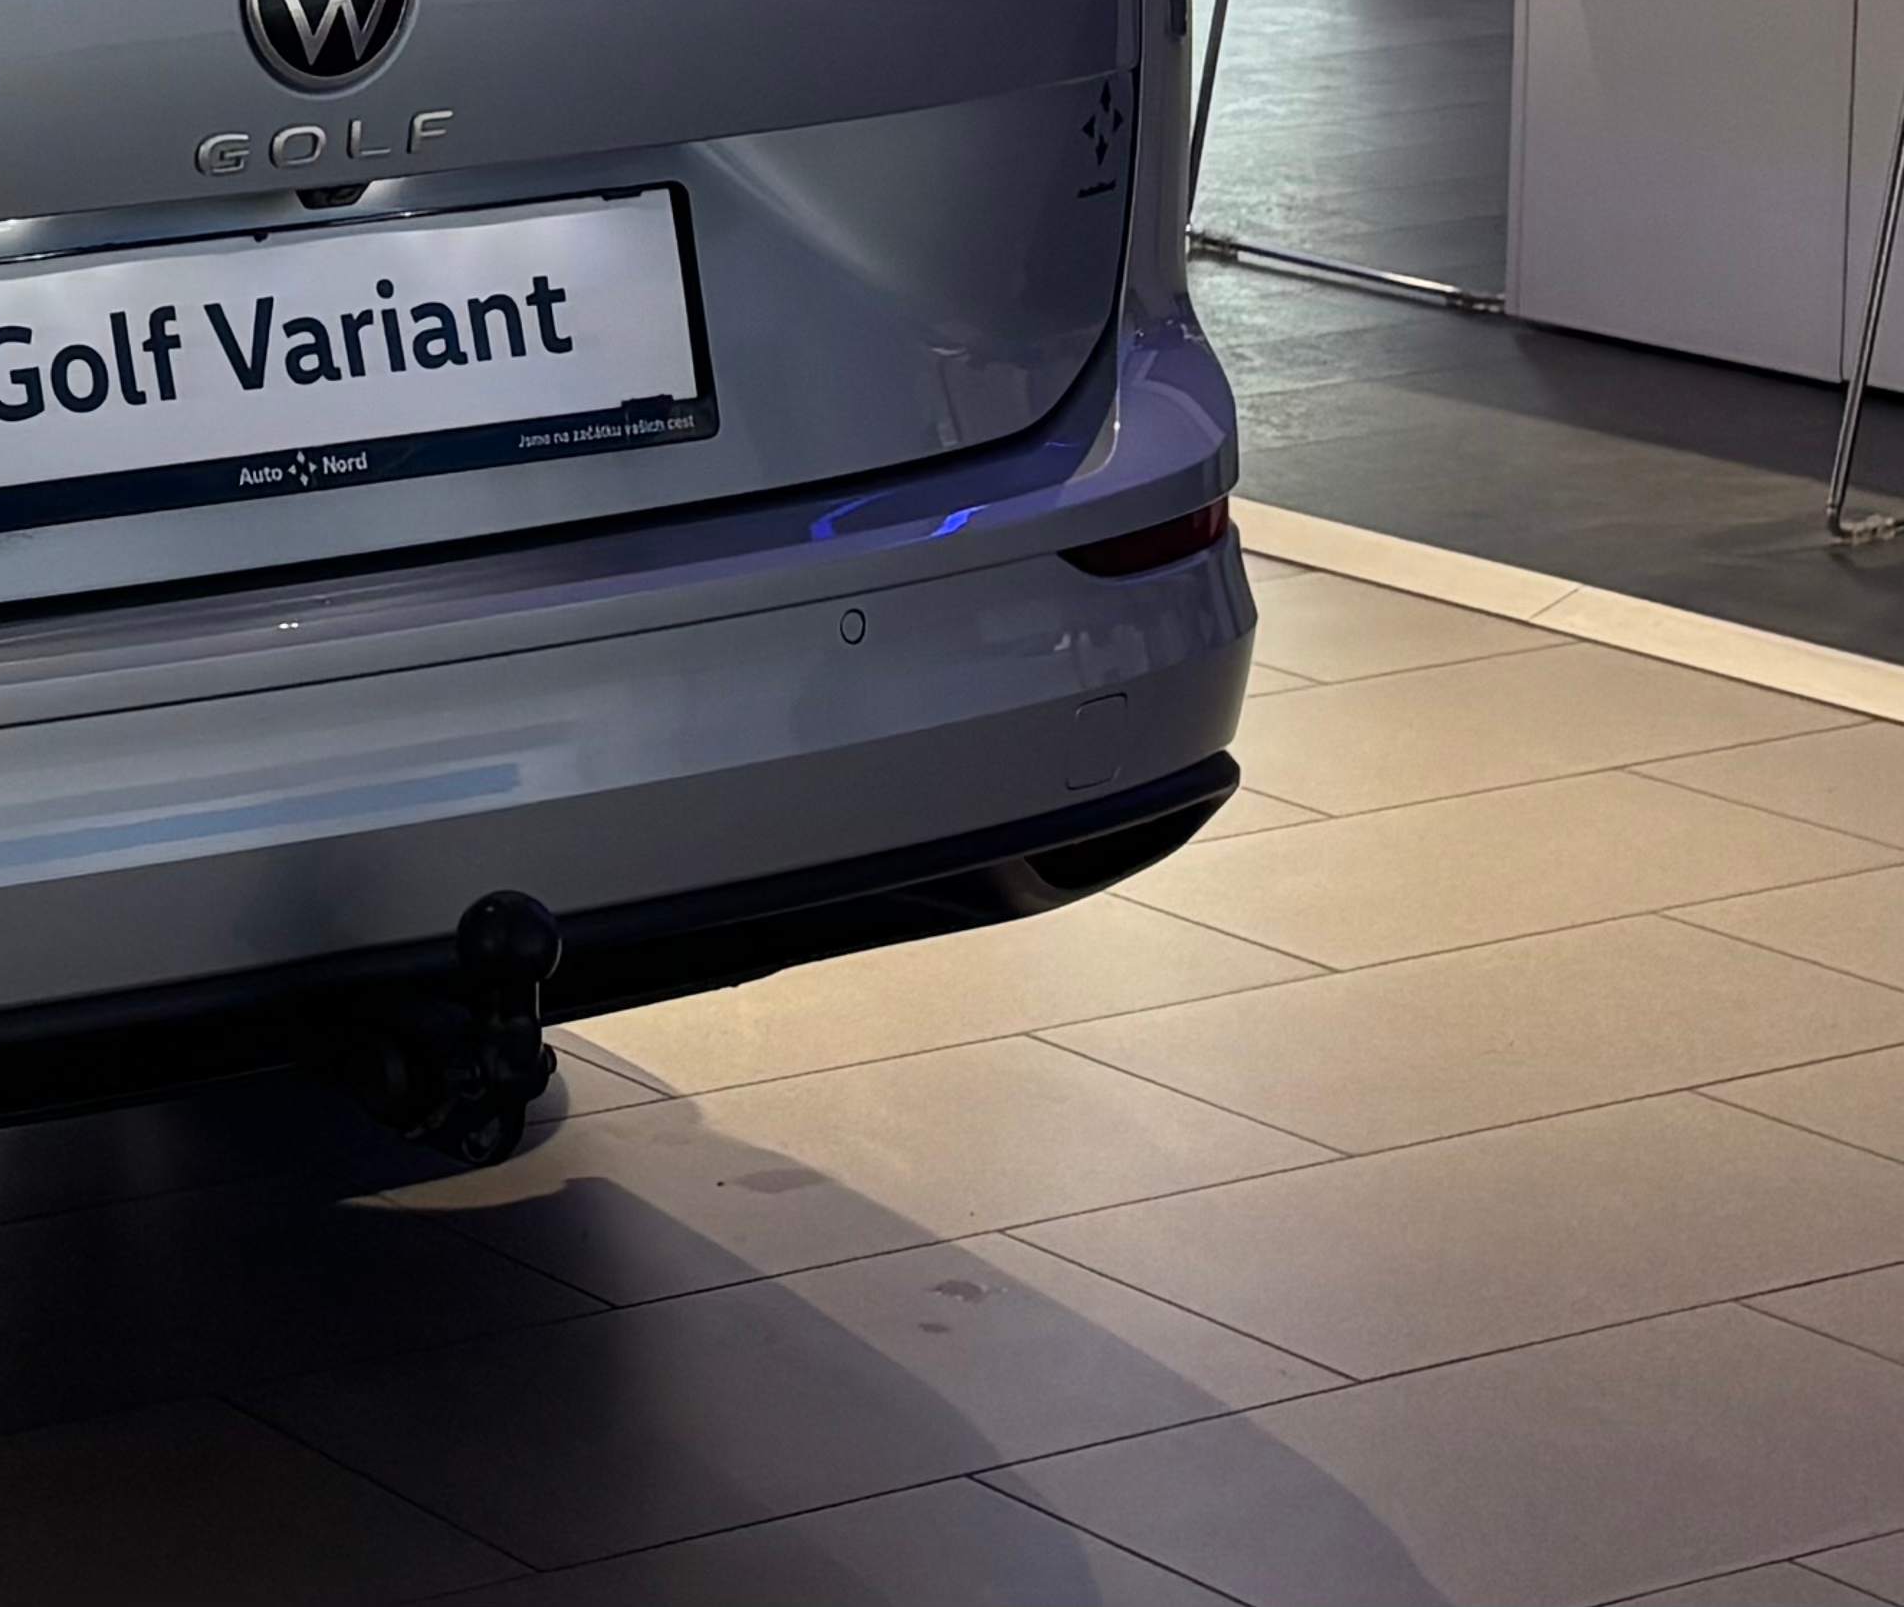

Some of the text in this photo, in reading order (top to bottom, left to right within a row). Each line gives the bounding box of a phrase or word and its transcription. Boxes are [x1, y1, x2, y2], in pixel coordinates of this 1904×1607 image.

[195, 110, 454, 175] GOLF
[203, 275, 574, 391] Variant
[666, 414, 696, 432] cest
[239, 450, 369, 487] Auto Nord
